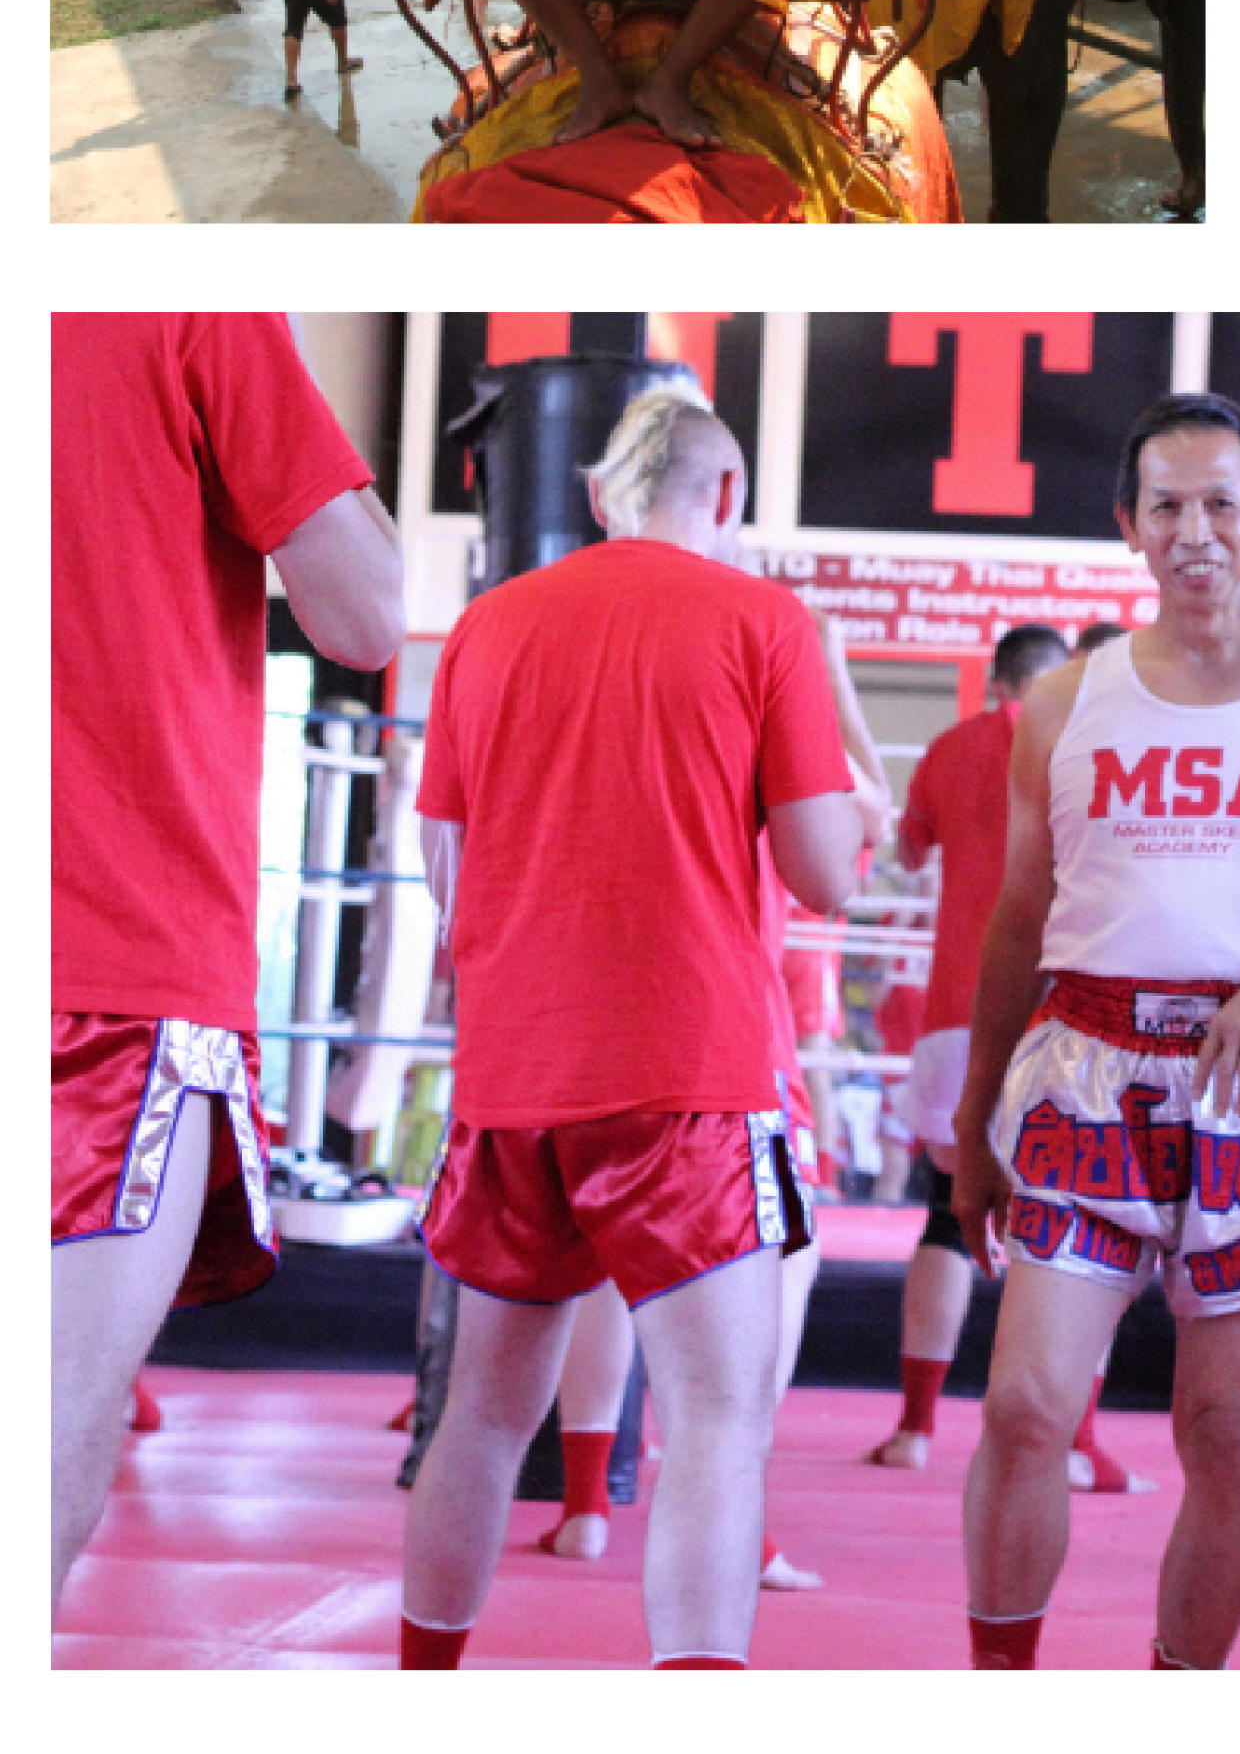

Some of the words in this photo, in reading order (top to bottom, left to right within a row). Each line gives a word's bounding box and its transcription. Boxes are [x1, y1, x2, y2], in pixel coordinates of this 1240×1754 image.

[850, 555, 957, 589] Muay
[968, 561, 1045, 588] Thai
[908, 587, 1122, 622] Instructors
[1112, 823, 1195, 838] MASTER
[1132, 842, 1233, 854] ACADEMY
